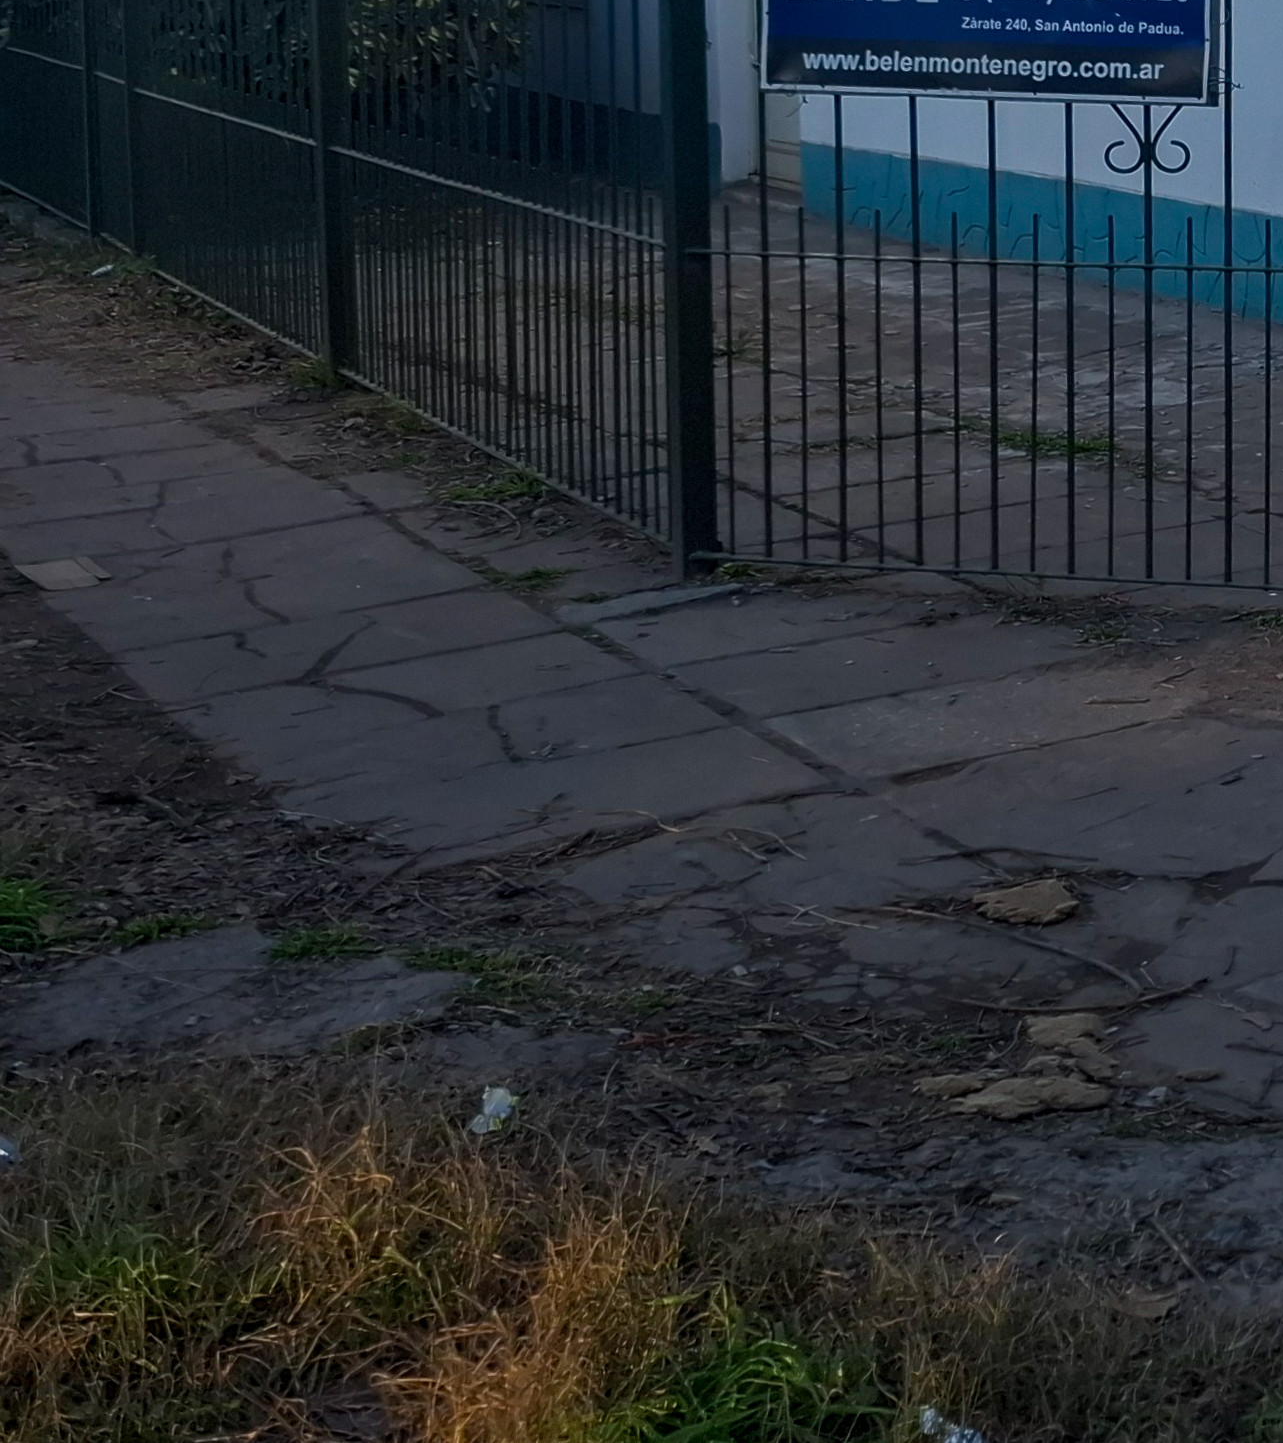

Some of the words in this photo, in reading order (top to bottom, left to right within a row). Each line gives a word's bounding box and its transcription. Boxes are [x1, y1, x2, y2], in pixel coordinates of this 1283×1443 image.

[1005, 18, 1031, 32] 240,
[1035, 19, 1060, 32] San
[1062, 20, 1114, 34] Antonio
[1118, 21, 1134, 34] de
[1139, 22, 1184, 36] Padua.
[802, 49, 1165, 82] www.belenmontenegro.com.ar
